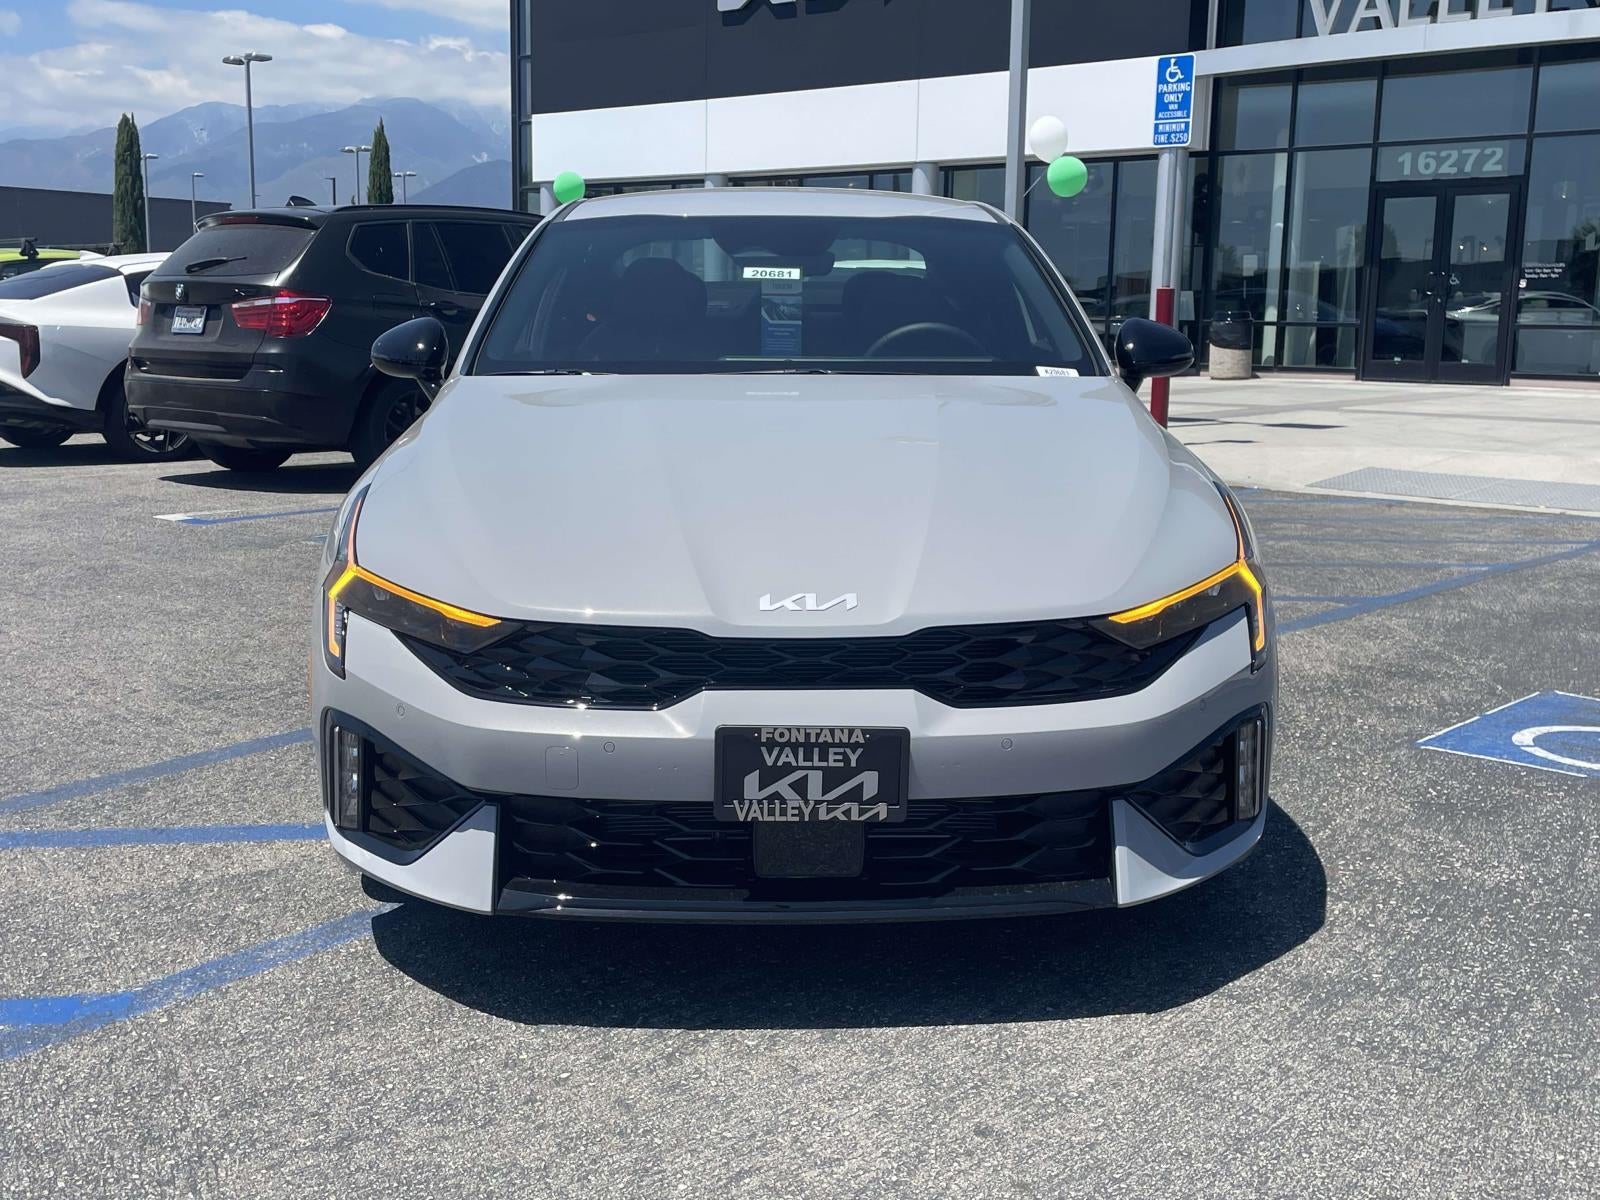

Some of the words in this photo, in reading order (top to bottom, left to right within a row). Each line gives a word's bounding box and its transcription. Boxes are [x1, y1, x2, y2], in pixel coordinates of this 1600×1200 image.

[1158, 82, 1191, 93] PARKING
[1164, 93, 1184, 103] ONLY
[1158, 110, 1187, 119] ACCESSIBLE
[1158, 122, 1185, 132] MINIMUM
[1155, 134, 1168, 143] FINE
[1170, 132, 1188, 143] $250
[1398, 147, 1504, 176] 16272
[751, 269, 792, 278] 20681
[759, 592, 858, 612] KIA
[760, 728, 866, 744] FONTANA
[760, 746, 864, 767] VALLEY
[744, 769, 879, 802] KIA
[733, 800, 816, 822] VALLEY
[818, 802, 888, 821] KIA
